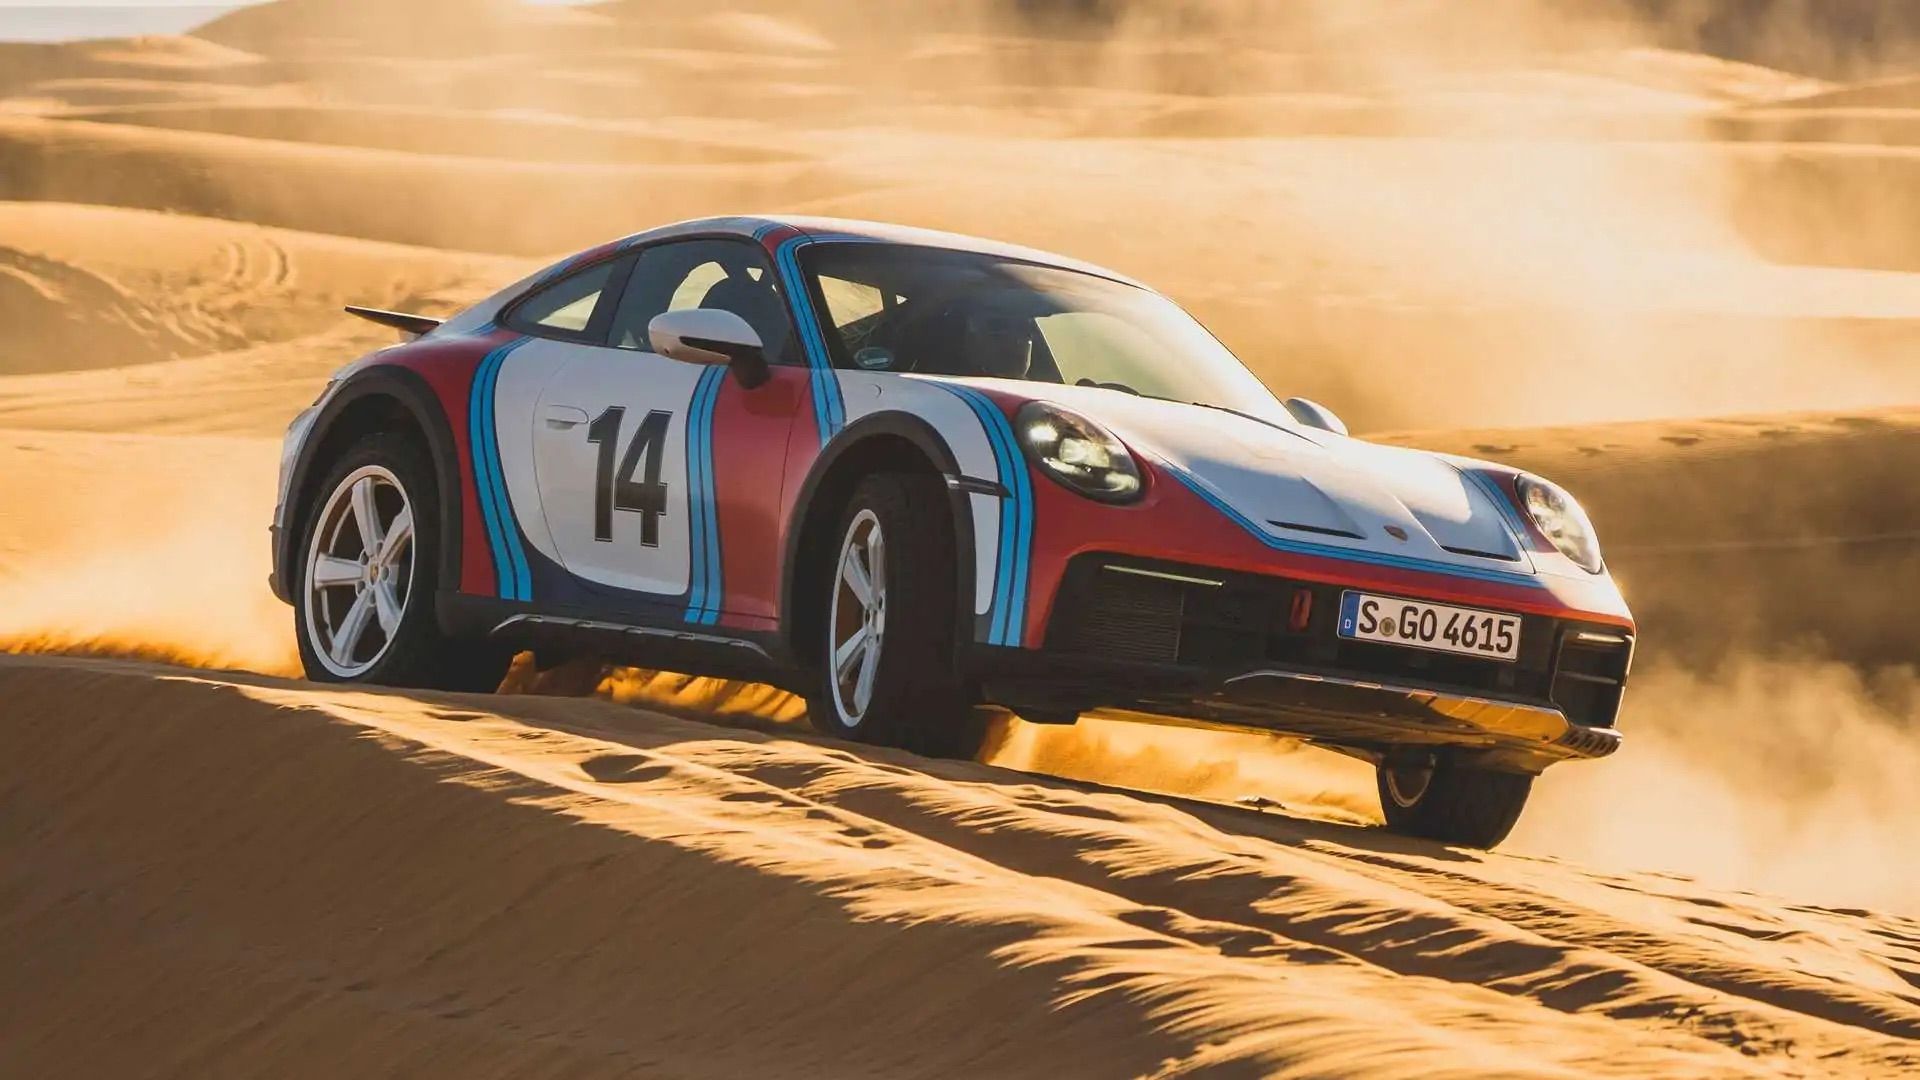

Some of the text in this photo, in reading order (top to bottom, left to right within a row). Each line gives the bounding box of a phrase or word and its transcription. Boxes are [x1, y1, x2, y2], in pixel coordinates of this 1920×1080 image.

[587, 405, 674, 548] 14
[1344, 618, 1352, 629] D
[1359, 600, 1515, 653] S GO 4615
